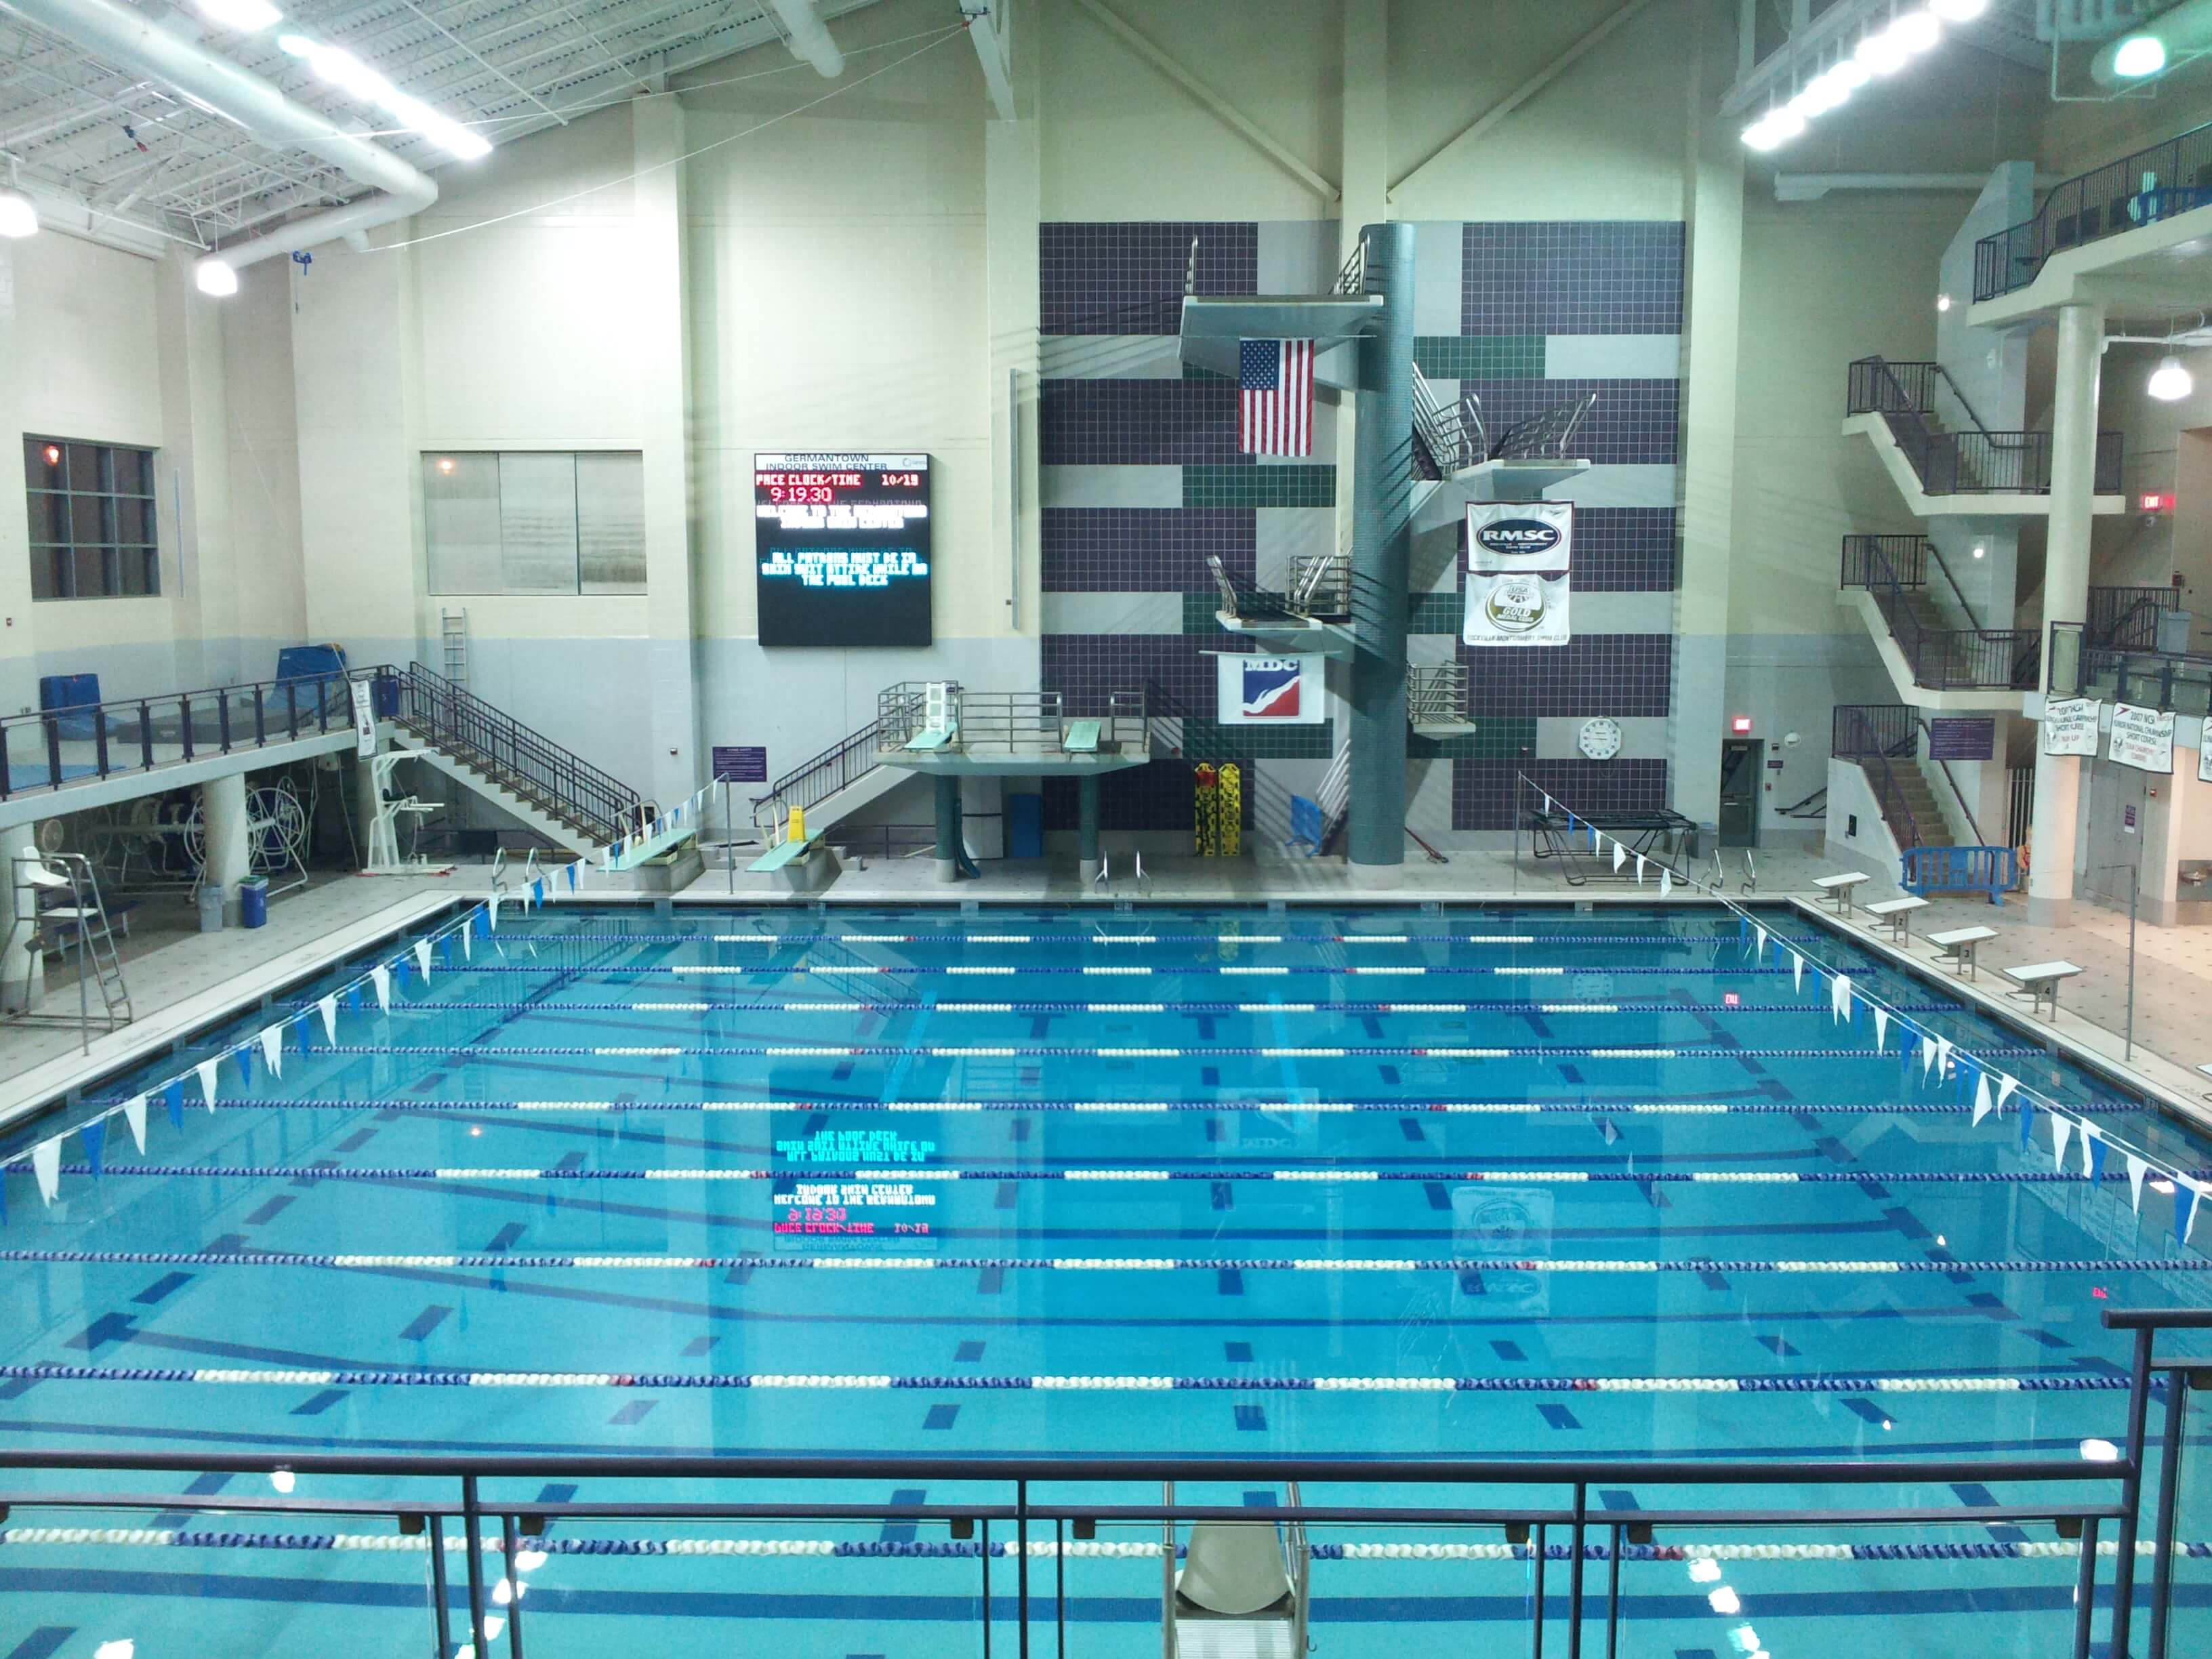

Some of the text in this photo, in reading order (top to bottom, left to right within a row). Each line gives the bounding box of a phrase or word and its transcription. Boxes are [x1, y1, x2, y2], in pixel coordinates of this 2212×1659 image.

[785, 454, 869, 462] GERMANTOWN
[1483, 530, 1555, 541] RMSC
[1502, 607, 1532, 617] GOLD
